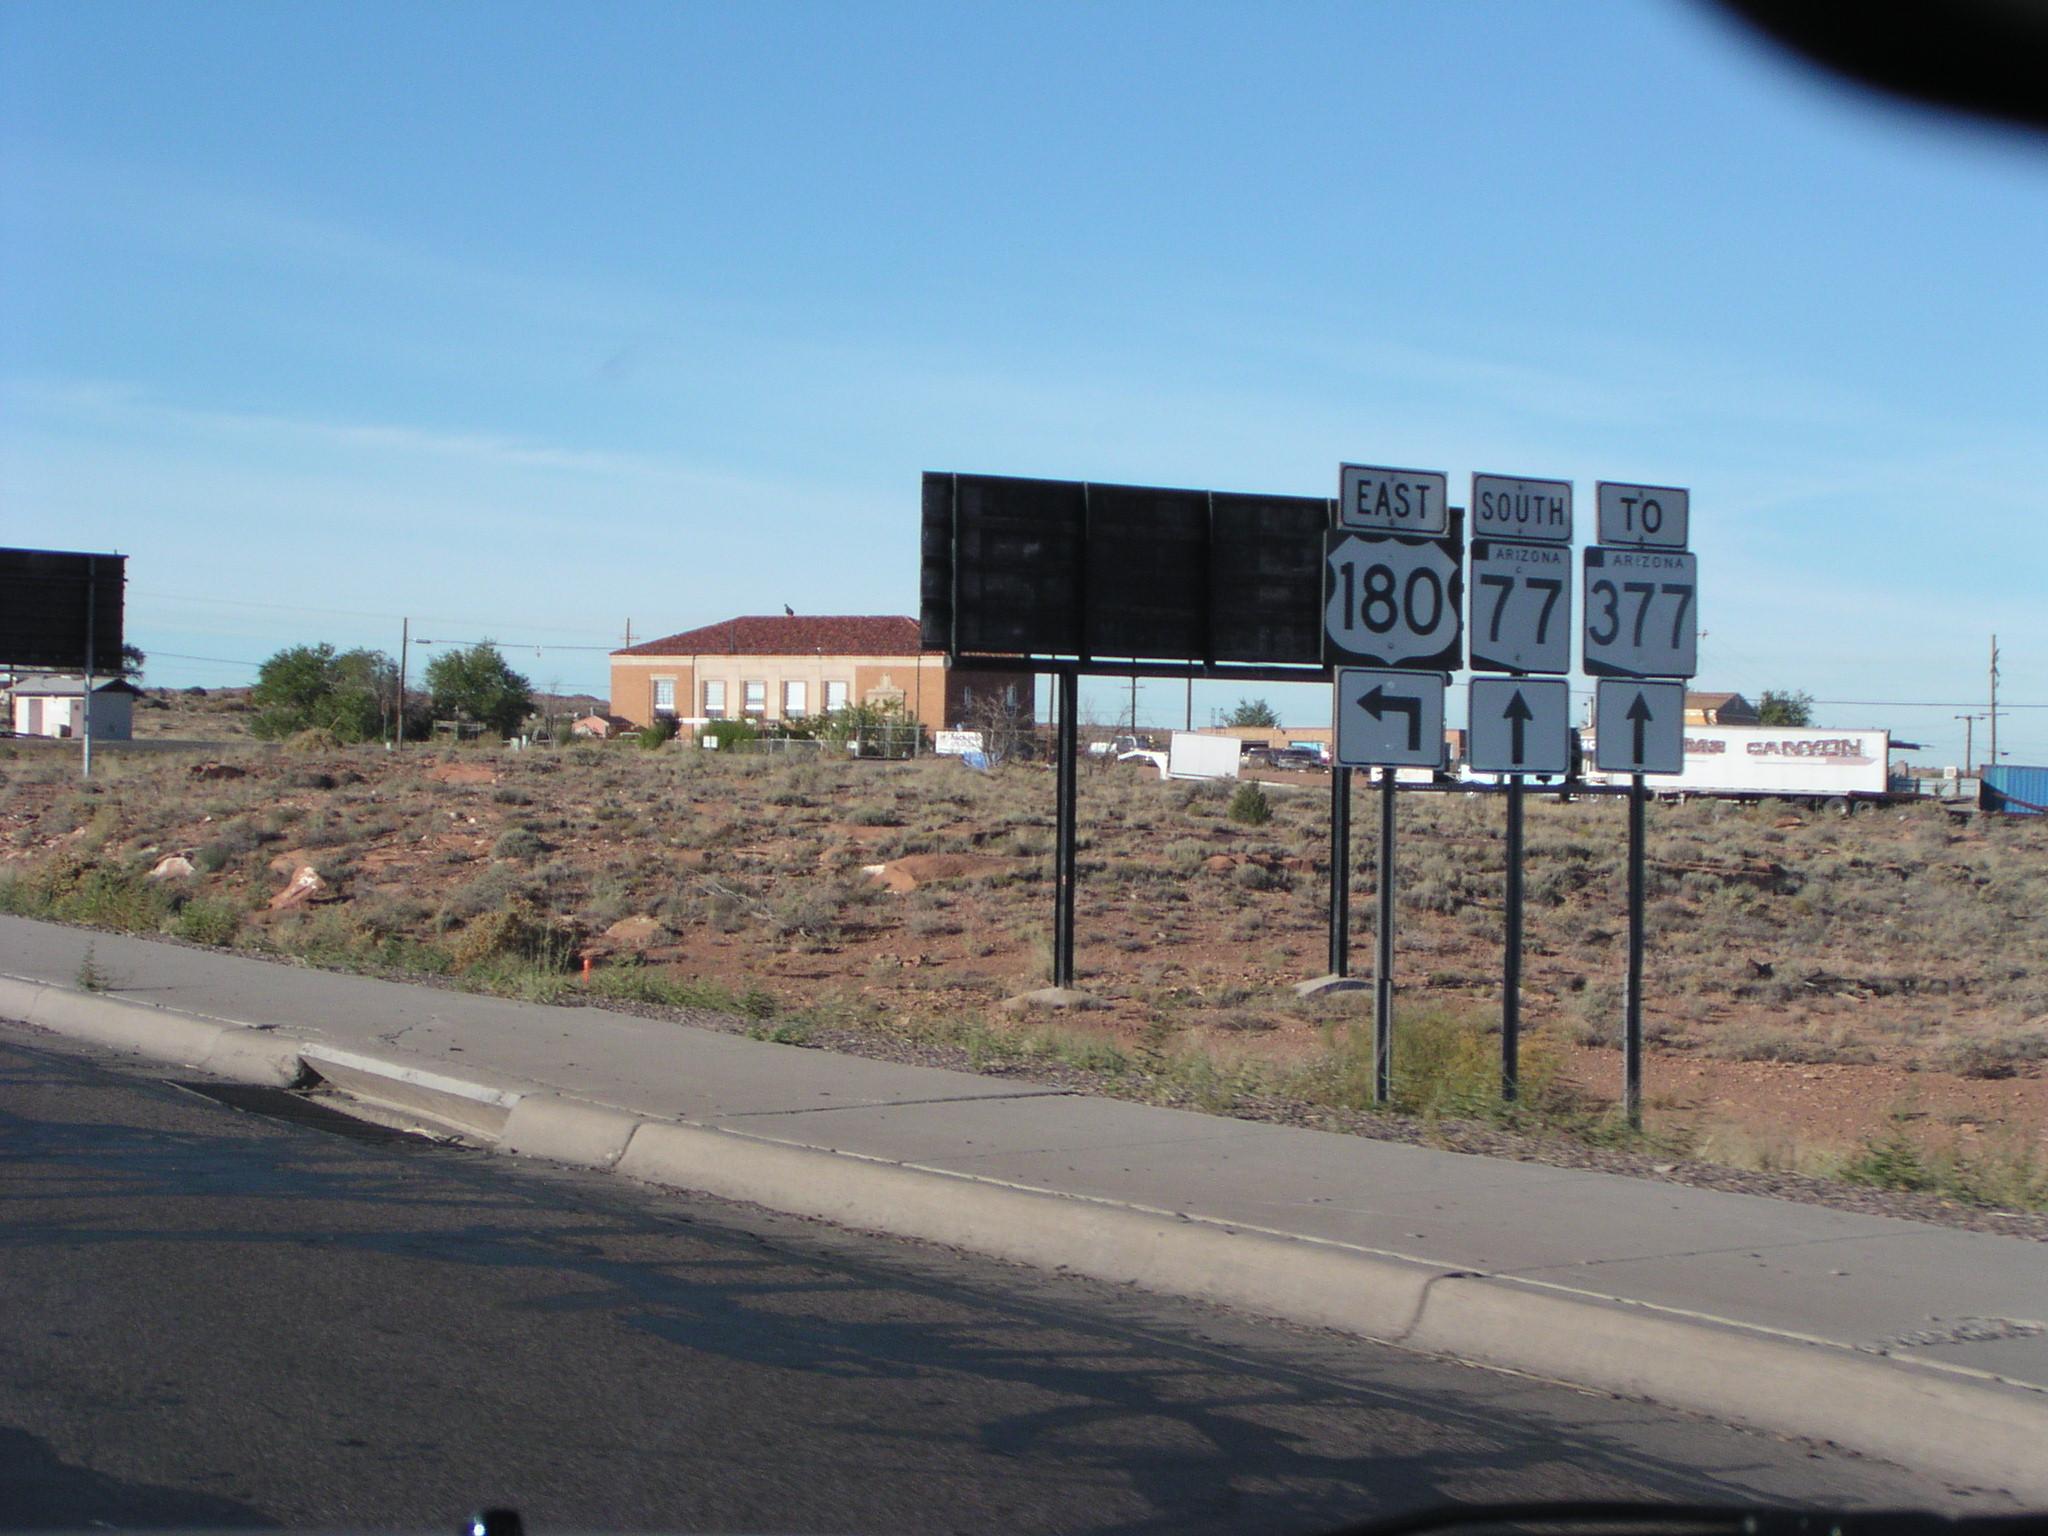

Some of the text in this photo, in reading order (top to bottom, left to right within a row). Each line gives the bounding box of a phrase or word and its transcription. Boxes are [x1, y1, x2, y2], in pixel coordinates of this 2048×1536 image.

[1356, 479, 1431, 520] EAST
[1481, 490, 1564, 526] SOUTH
[1620, 496, 1663, 534] TO
[1495, 549, 1561, 564] ARIZONA
[1612, 554, 1685, 569] ARIZONA
[1340, 561, 1443, 636] 180
[1479, 573, 1563, 645] 77
[1588, 579, 1693, 650] 377
